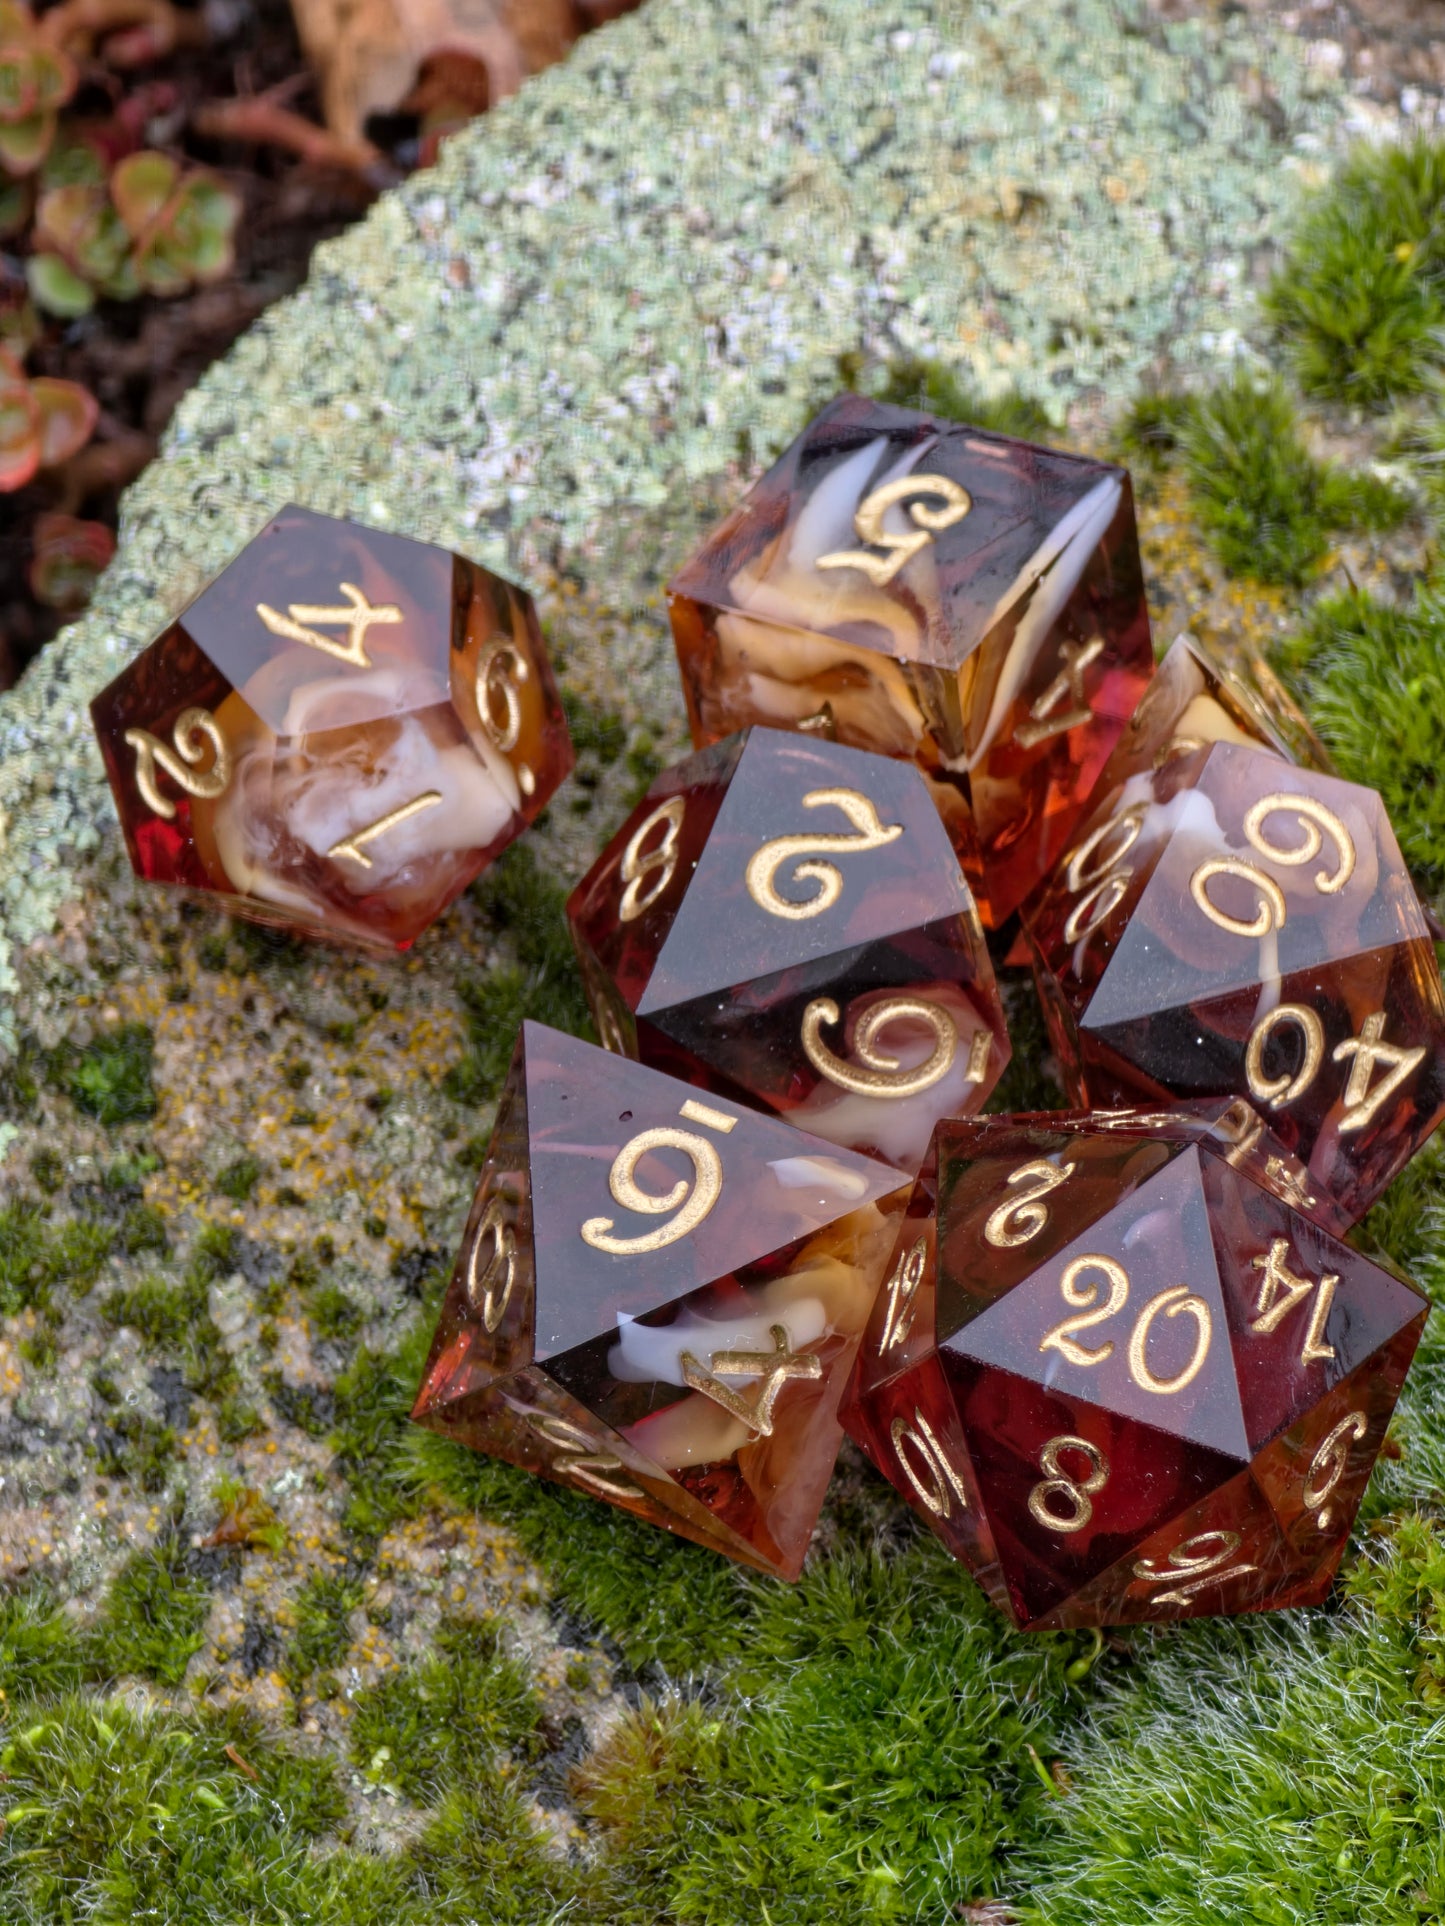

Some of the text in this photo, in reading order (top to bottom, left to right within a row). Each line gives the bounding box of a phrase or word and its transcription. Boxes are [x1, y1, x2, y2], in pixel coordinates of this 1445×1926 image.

[816, 473, 972, 586] 5
[256, 582, 405, 669] 4
[124, 707, 232, 819] 2
[327, 789, 442, 870] 1
[619, 795, 686, 923] 8
[744, 785, 904, 920] 2
[1245, 1001, 1428, 1134] 40
[984, 1158, 1076, 1249] 2
[1040, 1253, 1214, 1395] 20
[1251, 1237, 1341, 1368] 14
[679, 1323, 823, 1438] 4
[1027, 1434, 1110, 1535] 8
[1131, 1530, 1259, 1606] 16
